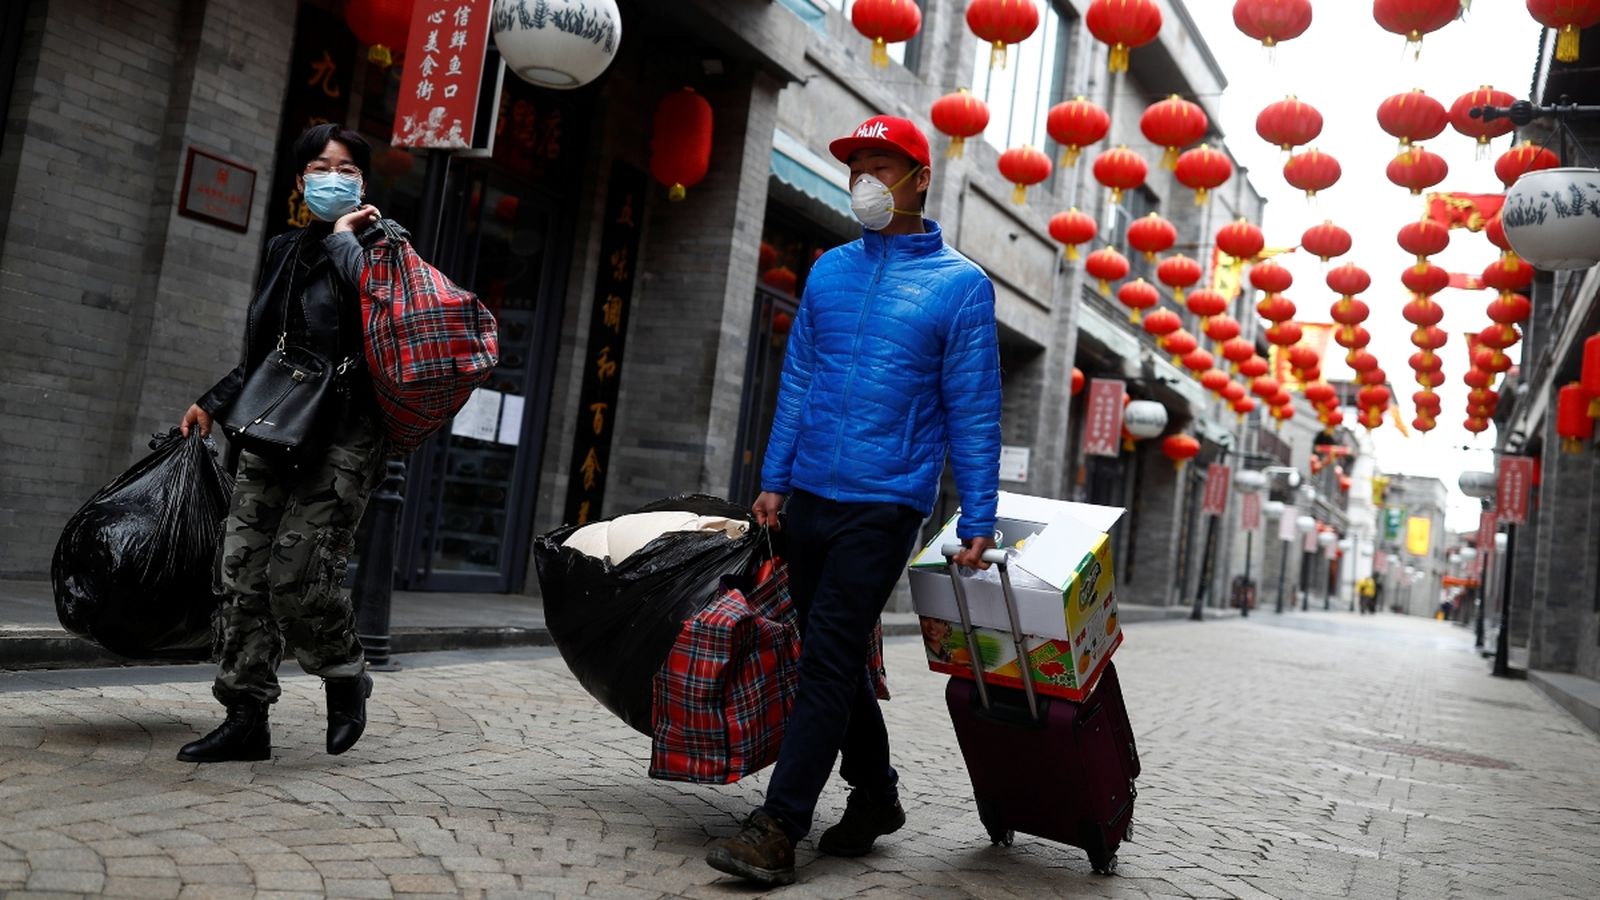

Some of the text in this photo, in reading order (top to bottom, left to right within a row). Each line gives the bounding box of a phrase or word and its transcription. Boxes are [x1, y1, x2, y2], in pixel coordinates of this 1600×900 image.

[416, 0, 448, 101] 心美食街
[444, 0, 475, 98] 信鲜鱼口
[856, 121, 889, 140] Hulk
